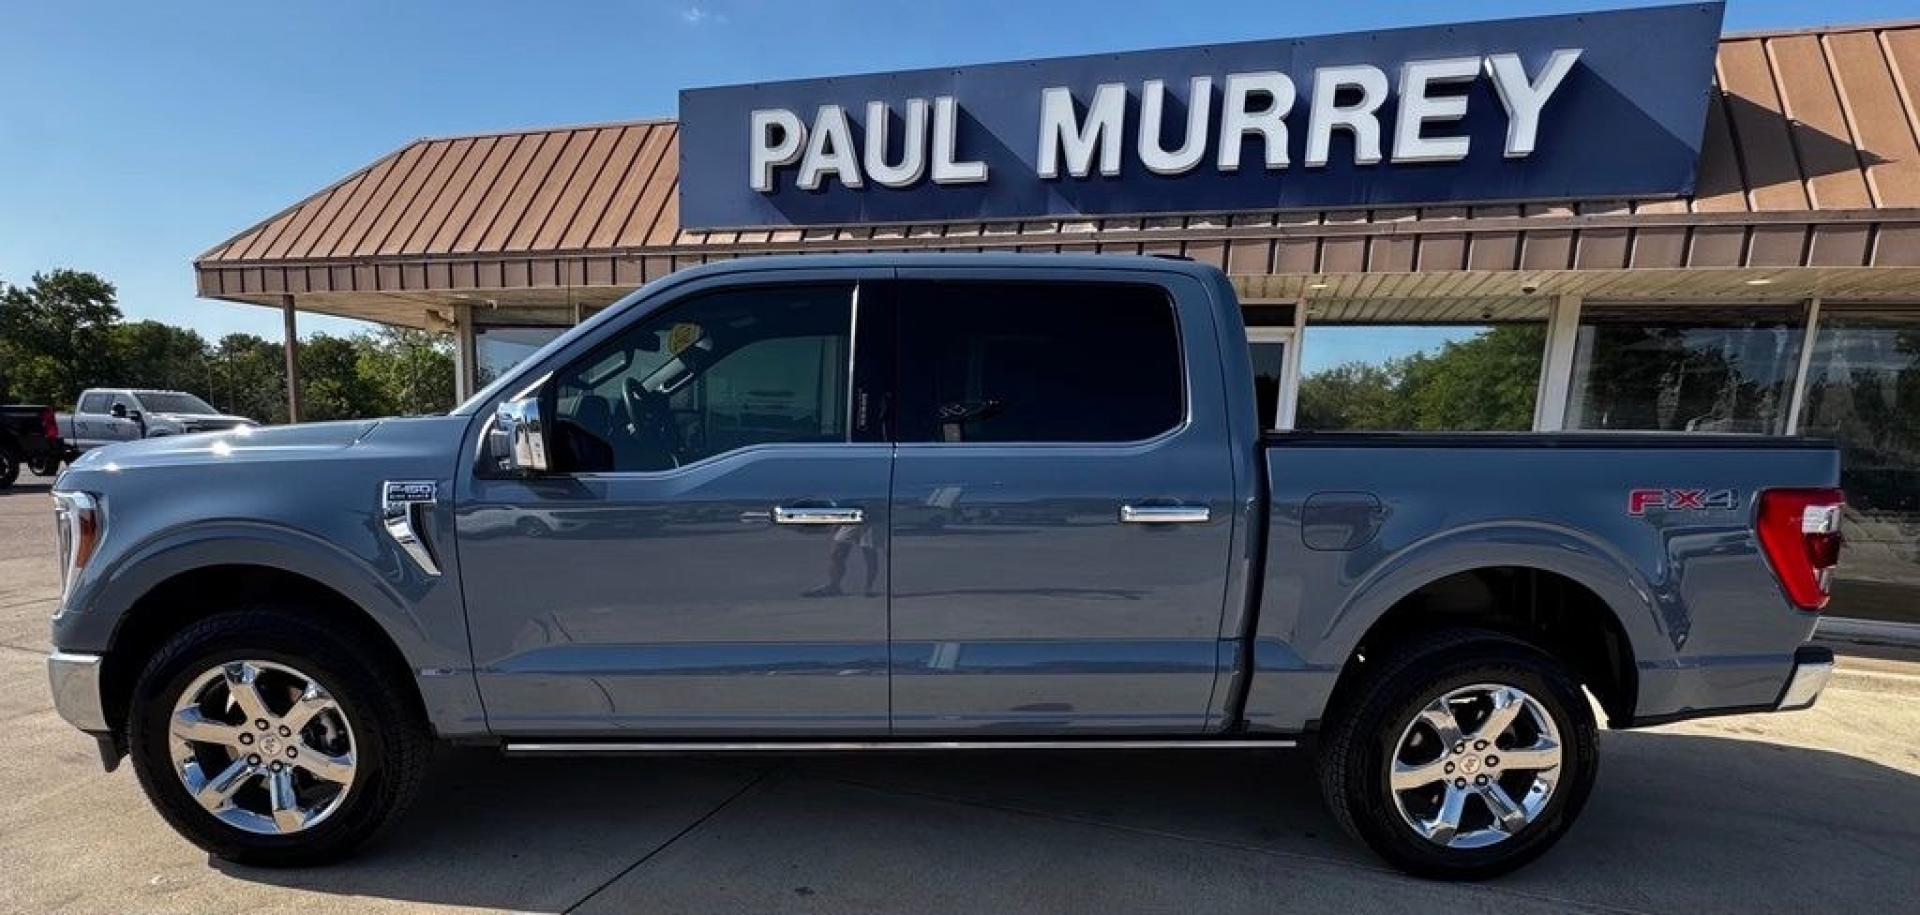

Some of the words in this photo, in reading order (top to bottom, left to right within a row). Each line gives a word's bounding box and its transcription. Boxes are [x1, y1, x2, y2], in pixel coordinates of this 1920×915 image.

[751, 96, 988, 191] PAUL
[1036, 48, 1583, 178] MURREY
[1628, 488, 1739, 516] FX4
